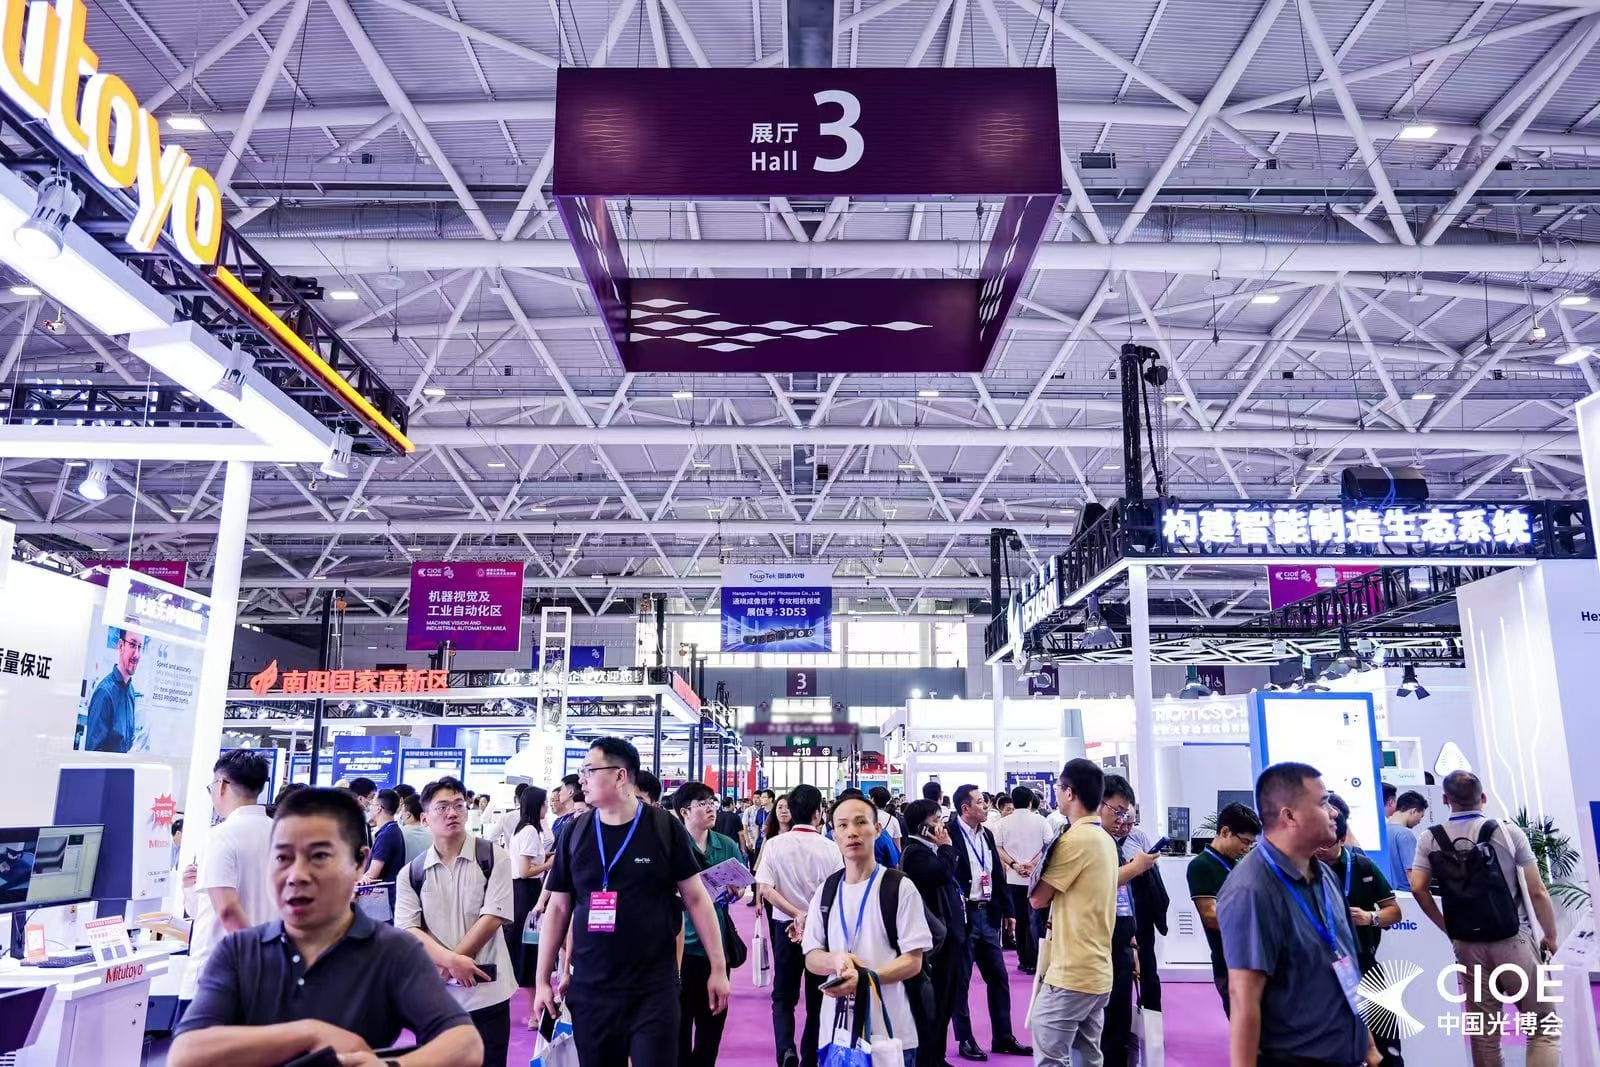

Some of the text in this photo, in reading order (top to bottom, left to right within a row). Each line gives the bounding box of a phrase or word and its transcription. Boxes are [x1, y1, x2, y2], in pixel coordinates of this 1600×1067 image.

[750, 122, 799, 144] 展厅
[813, 90, 865, 173] 3
[751, 150, 798, 171] Hall
[1162, 508, 1531, 545] 构建智能制造生态系统
[749, 572, 776, 581] ToupTek
[428, 590, 490, 603] 机器视觉及
[427, 605, 503, 617] 工业自动化区
[1581, 611, 1600, 622] He
[282, 669, 450, 694] 南阳国家高新区
[797, 672, 807, 690] 3
[1390, 919, 1417, 930] onic
[105, 964, 144, 983] Mitutoyo
